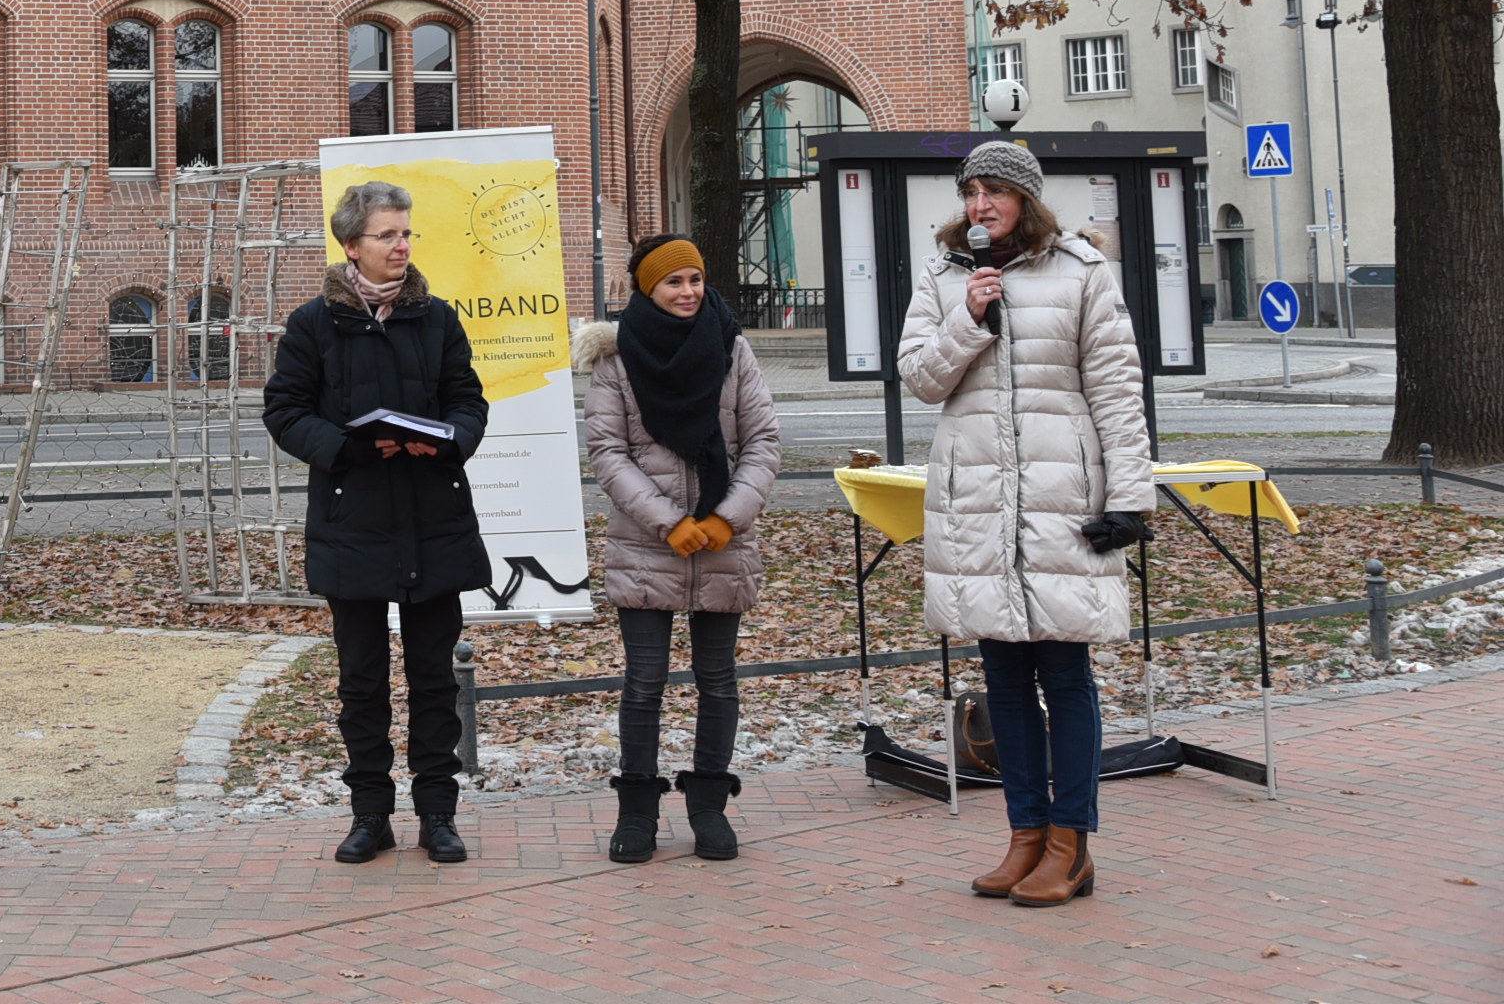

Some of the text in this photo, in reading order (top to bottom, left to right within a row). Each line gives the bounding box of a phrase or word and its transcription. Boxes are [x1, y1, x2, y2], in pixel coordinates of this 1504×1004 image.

[480, 197, 526, 219] DU BIST
[490, 210, 526, 229] NICHT
[492, 220, 536, 242] ALLEIN!
[443, 294, 559, 318] NBAND
[534, 333, 554, 343] und
[483, 349, 556, 362] Kinderwunsch
